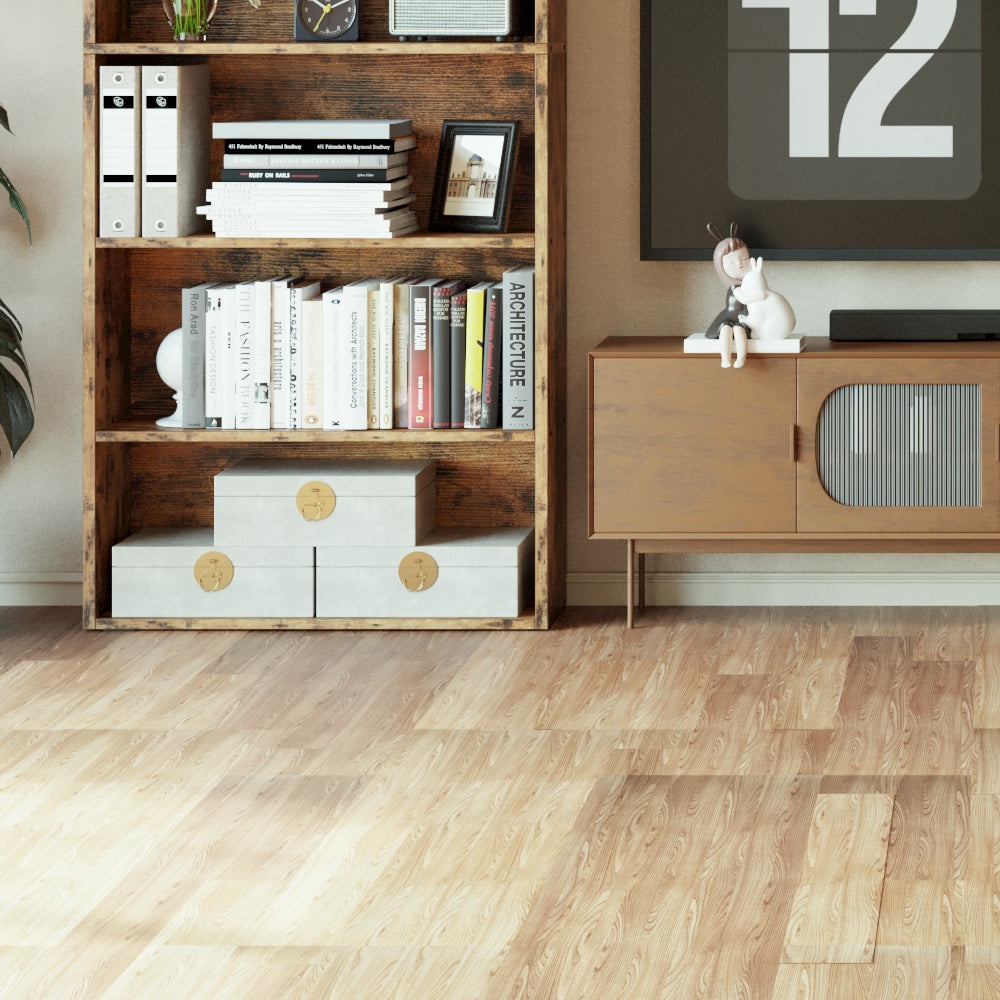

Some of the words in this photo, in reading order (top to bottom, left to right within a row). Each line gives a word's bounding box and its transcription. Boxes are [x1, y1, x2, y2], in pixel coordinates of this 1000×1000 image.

[190, 293, 199, 311] Ron
[240, 288, 250, 317] THE
[190, 313, 199, 335] Arad
[350, 311, 358, 345] Architects
[414, 324, 427, 350] BAZAAR
[509, 282, 526, 387] ARCHITECTURE
[209, 325, 217, 361] FASHION
[240, 321, 250, 382] FASHION
[209, 363, 217, 394] DESIGN
[350, 361, 358, 409] Conversations
[240, 385, 250, 425] BOOK
